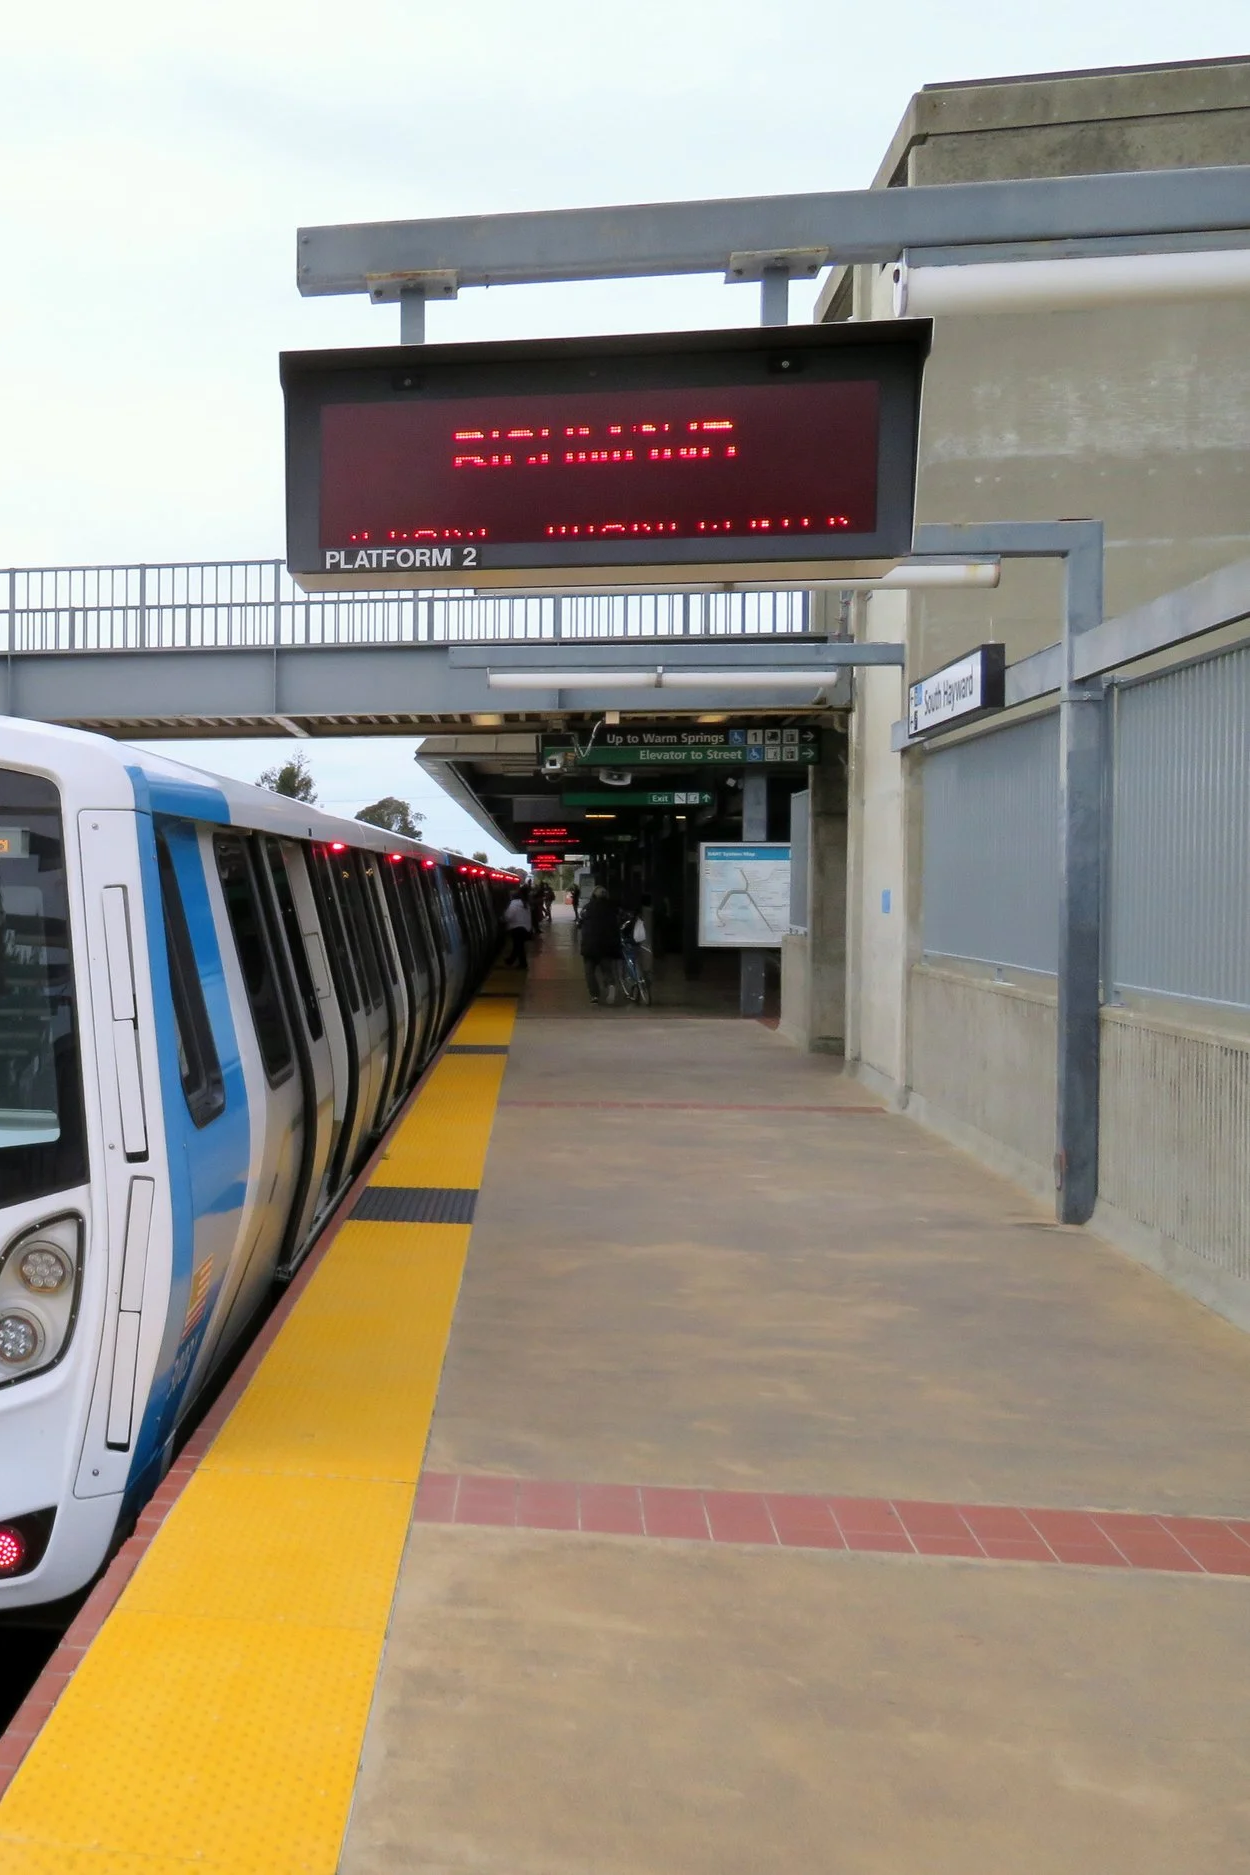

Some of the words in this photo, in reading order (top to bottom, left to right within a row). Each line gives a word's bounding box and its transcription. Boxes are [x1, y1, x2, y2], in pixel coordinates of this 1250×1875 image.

[325, 548, 452, 570] PLATFORM
[462, 547, 478, 567] 2
[924, 681, 942, 715] South
[943, 663, 973, 711] Hayward
[606, 734, 623, 745] Up
[626, 734, 639, 743] to
[643, 733, 677, 743] Warm
[680, 732, 725, 745] Springs
[639, 750, 686, 760] Elevator
[690, 750, 703, 760] to
[706, 749, 742, 760] Street
[652, 794, 668, 802] Exit
